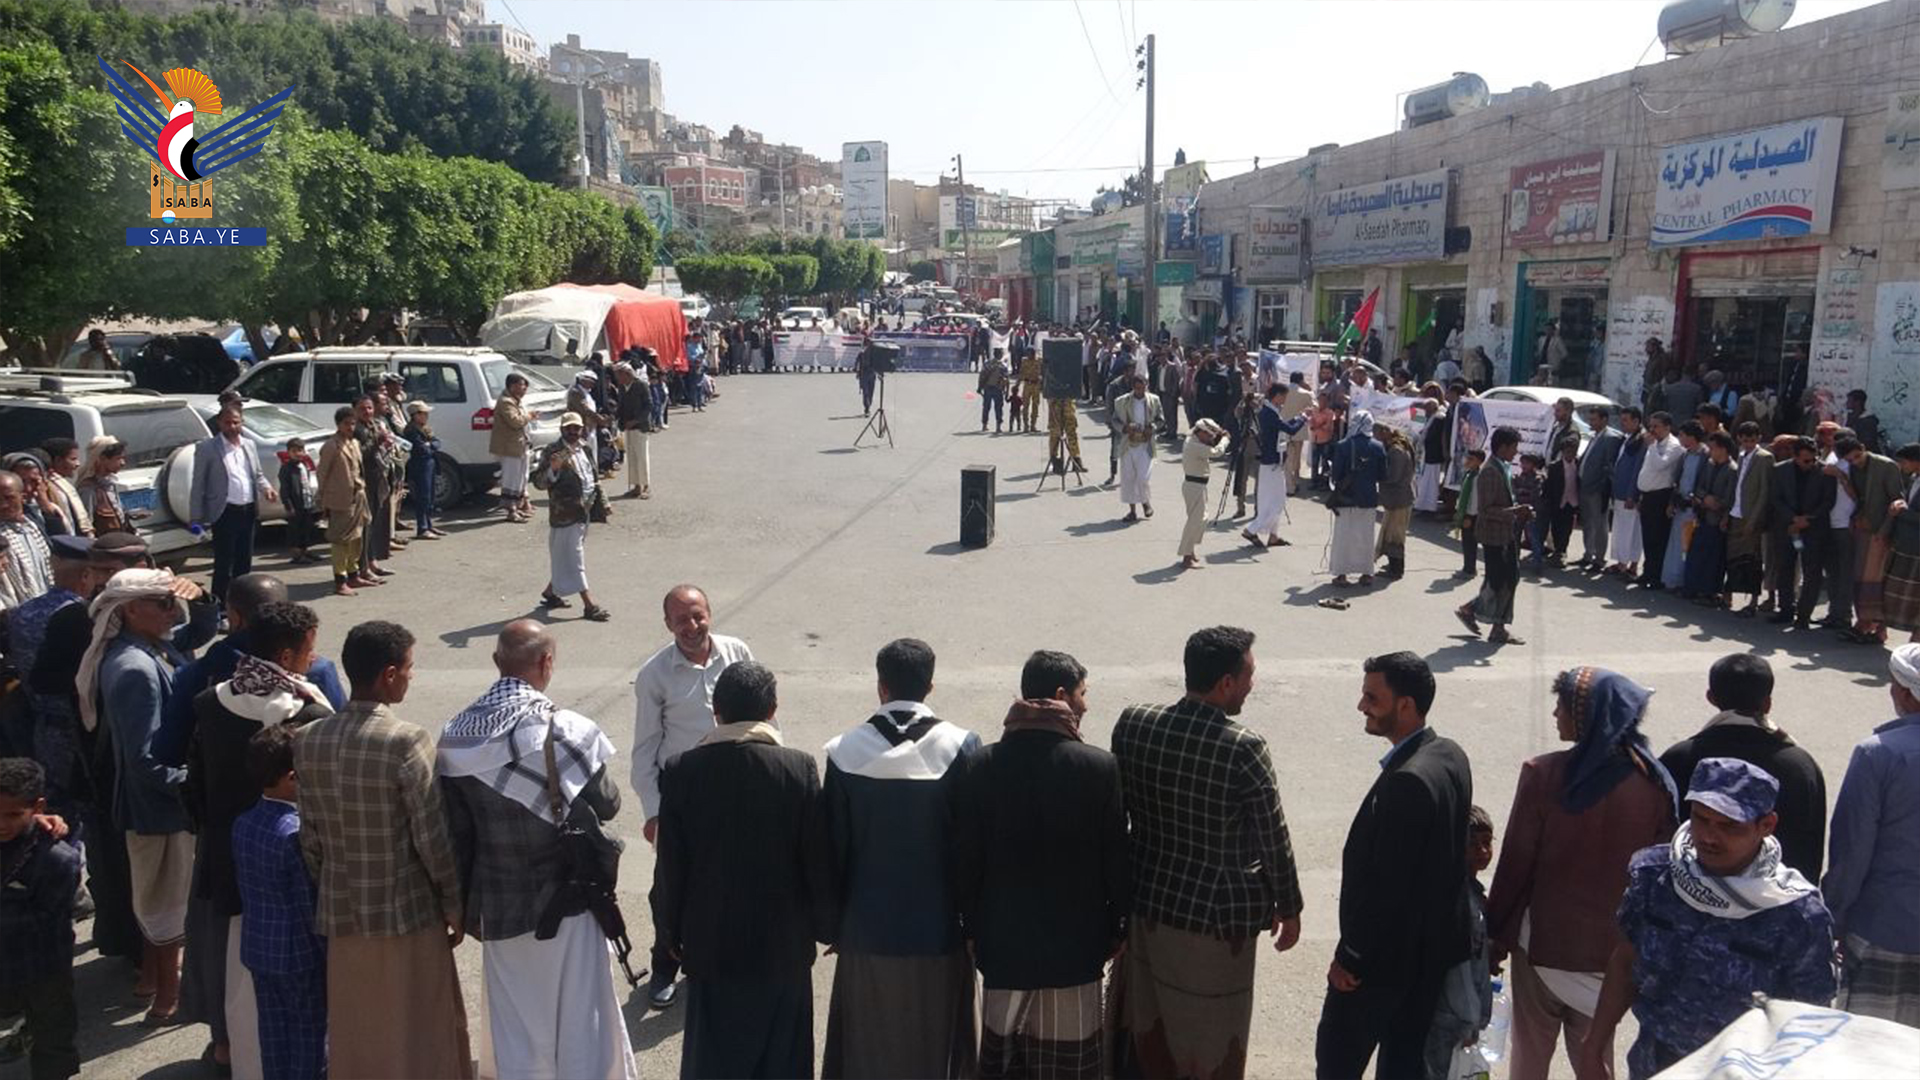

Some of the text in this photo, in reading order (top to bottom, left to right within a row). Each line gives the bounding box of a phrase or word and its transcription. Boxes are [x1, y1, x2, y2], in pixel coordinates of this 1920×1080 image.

[1662, 127, 1817, 190] الصيدلية المركزية
[1350, 184, 1393, 217] السعيدة
[1393, 180, 1444, 211] صيدلية
[1654, 211, 1716, 229] CENTRAL
[1722, 188, 1812, 219] PHARMACY
[1252, 217, 1299, 240] صيدلية
[1354, 218, 1390, 241] Al-Saedah
[1391, 217, 1430, 238] Pharmacy
[1251, 242, 1298, 260] السعيدة
